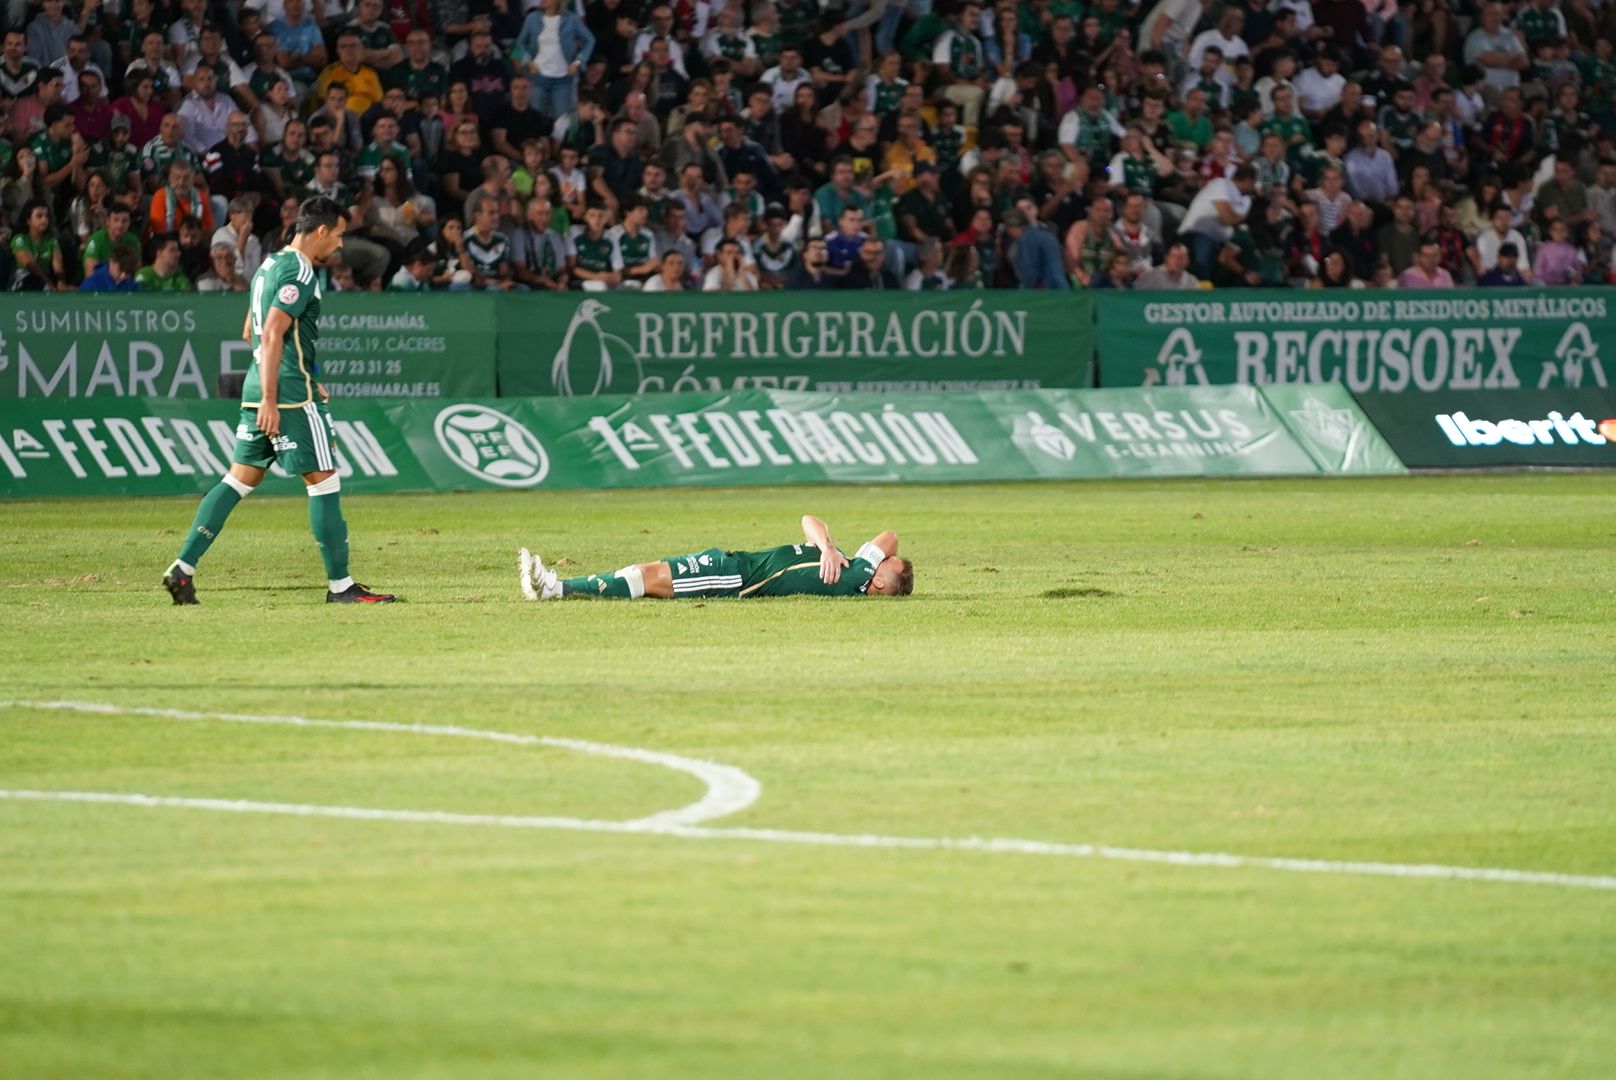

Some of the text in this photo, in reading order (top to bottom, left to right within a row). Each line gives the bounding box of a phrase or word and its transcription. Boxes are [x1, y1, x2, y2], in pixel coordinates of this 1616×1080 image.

[15, 310, 196, 332] SUMINISTROS
[1144, 293, 1606, 323] GESTOR AUTORIZADO DE RESIDUOS METÁLICOS
[635, 299, 1028, 358] REFRIGERACIÓN
[323, 359, 401, 374] 927 23 31 25
[1234, 327, 1522, 393] RECUSOEX
[649, 404, 979, 468] FEDERACIÓN
[1058, 409, 1251, 442] VERSUS
